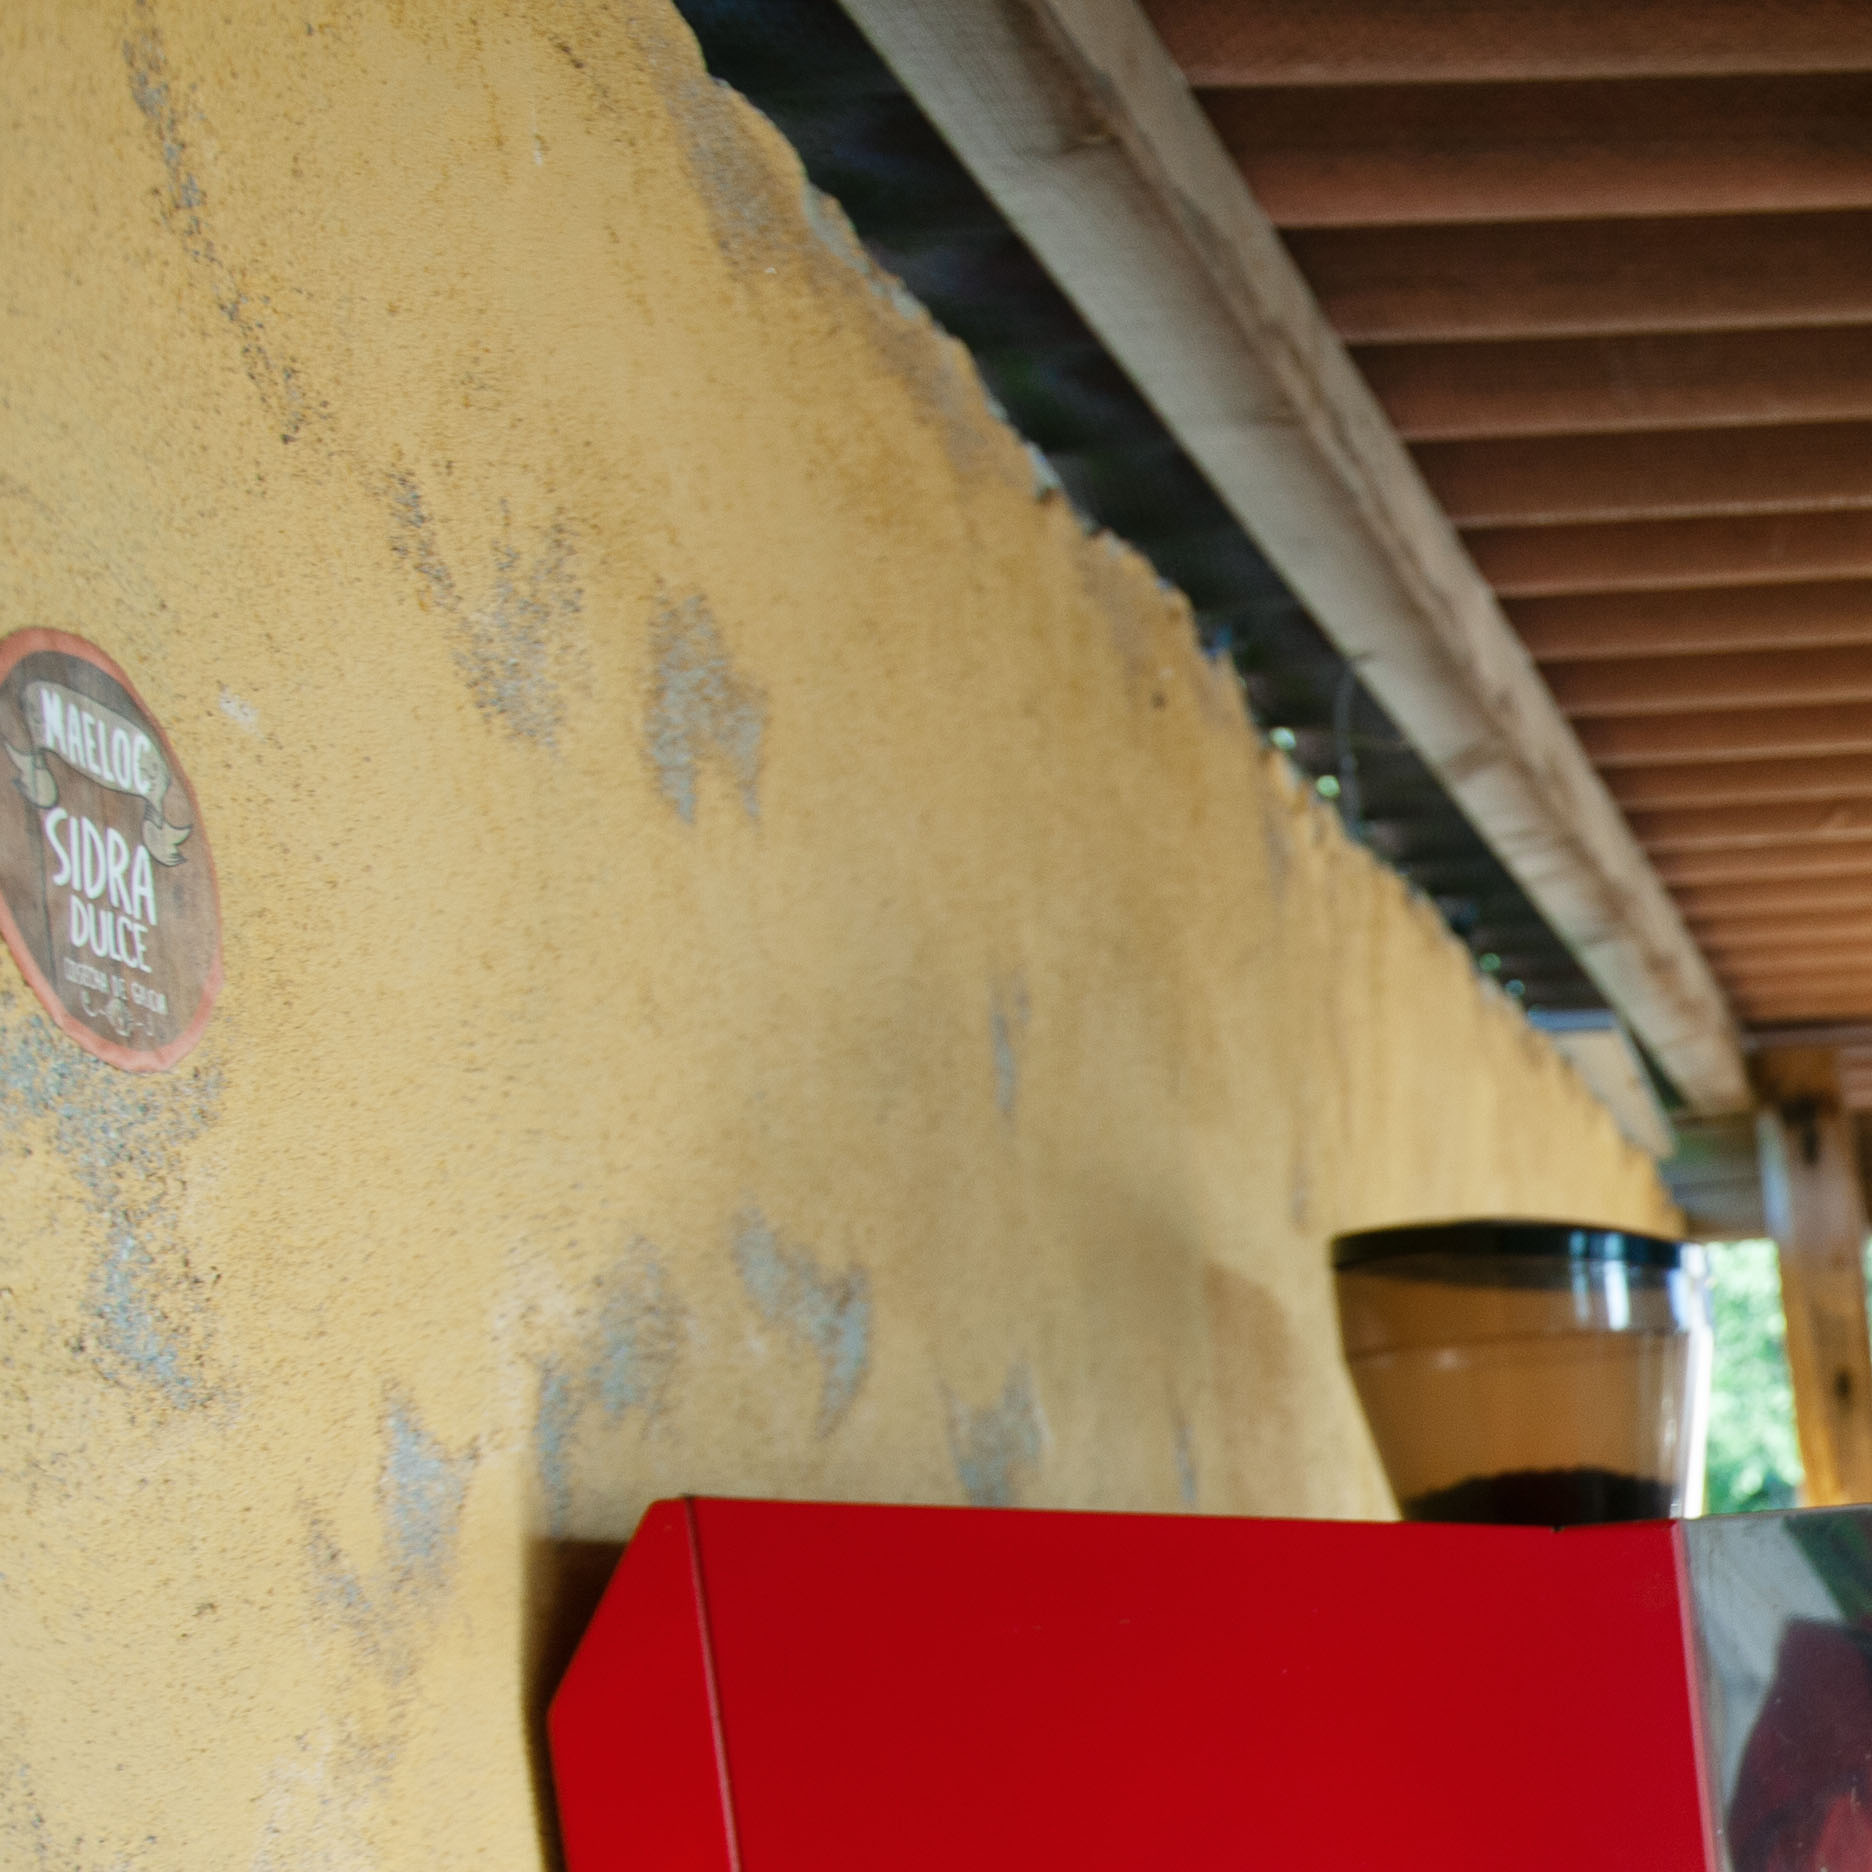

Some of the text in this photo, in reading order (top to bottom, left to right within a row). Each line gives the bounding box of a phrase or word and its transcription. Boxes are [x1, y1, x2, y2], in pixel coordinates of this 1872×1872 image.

[40, 687, 152, 795] MAELOC
[44, 807, 157, 926] SIDRA
[69, 895, 153, 973] DULCE
